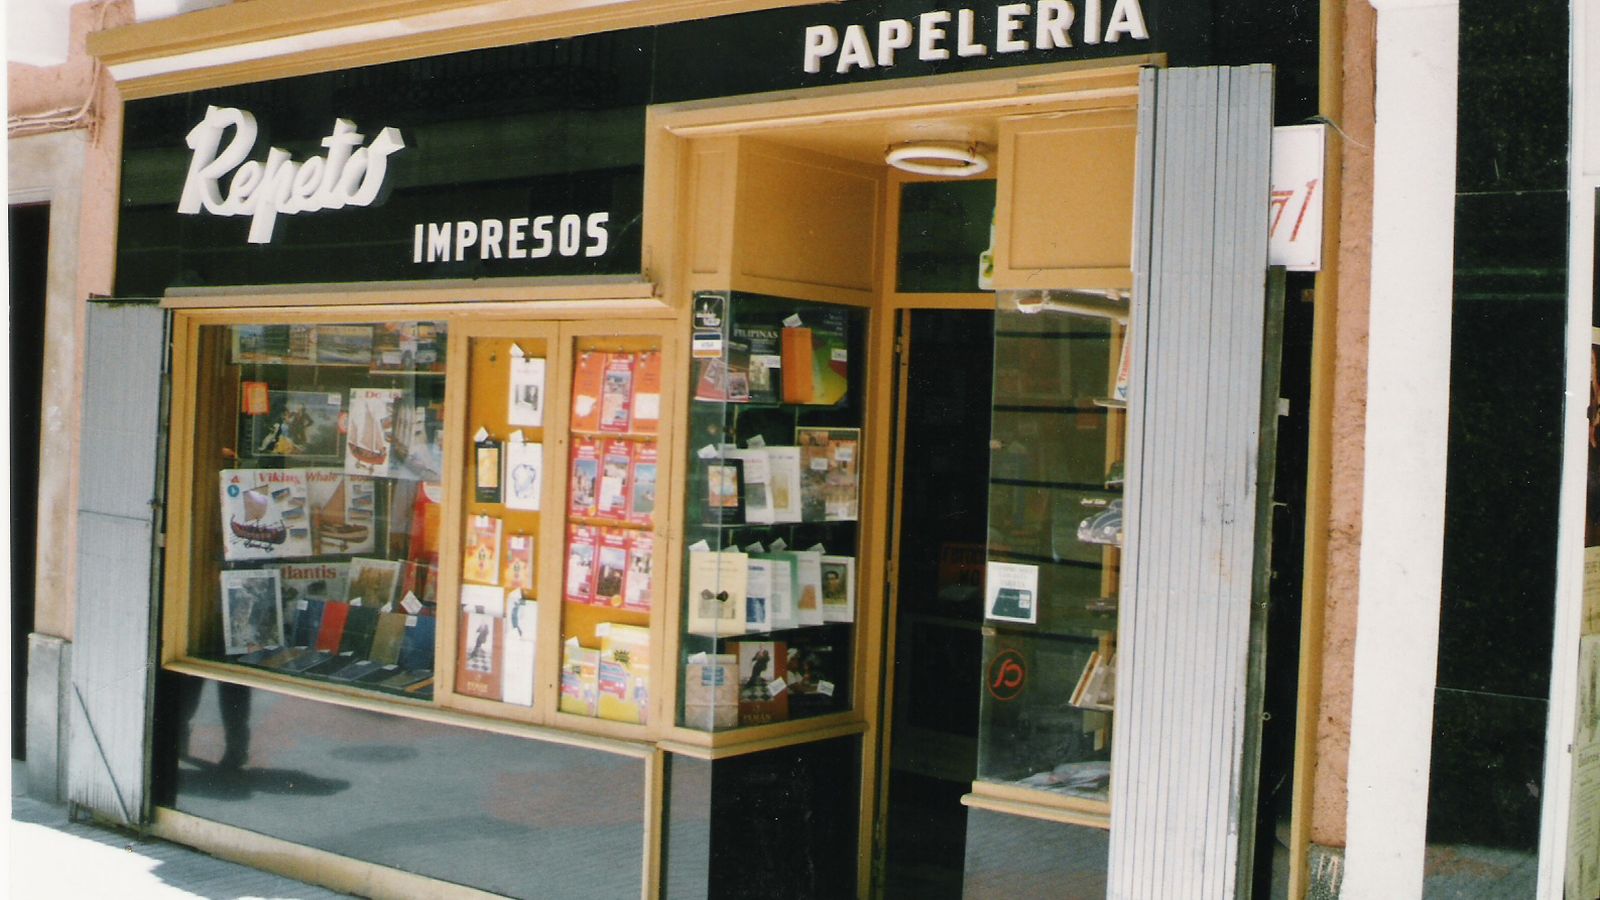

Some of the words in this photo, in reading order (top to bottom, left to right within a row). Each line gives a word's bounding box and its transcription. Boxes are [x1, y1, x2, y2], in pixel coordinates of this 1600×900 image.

[803, 0, 1150, 74] PAPELERIA
[413, 212, 609, 263] IMPRESOS
[733, 327, 778, 339] FILIPINAS
[258, 471, 301, 484] Viking
